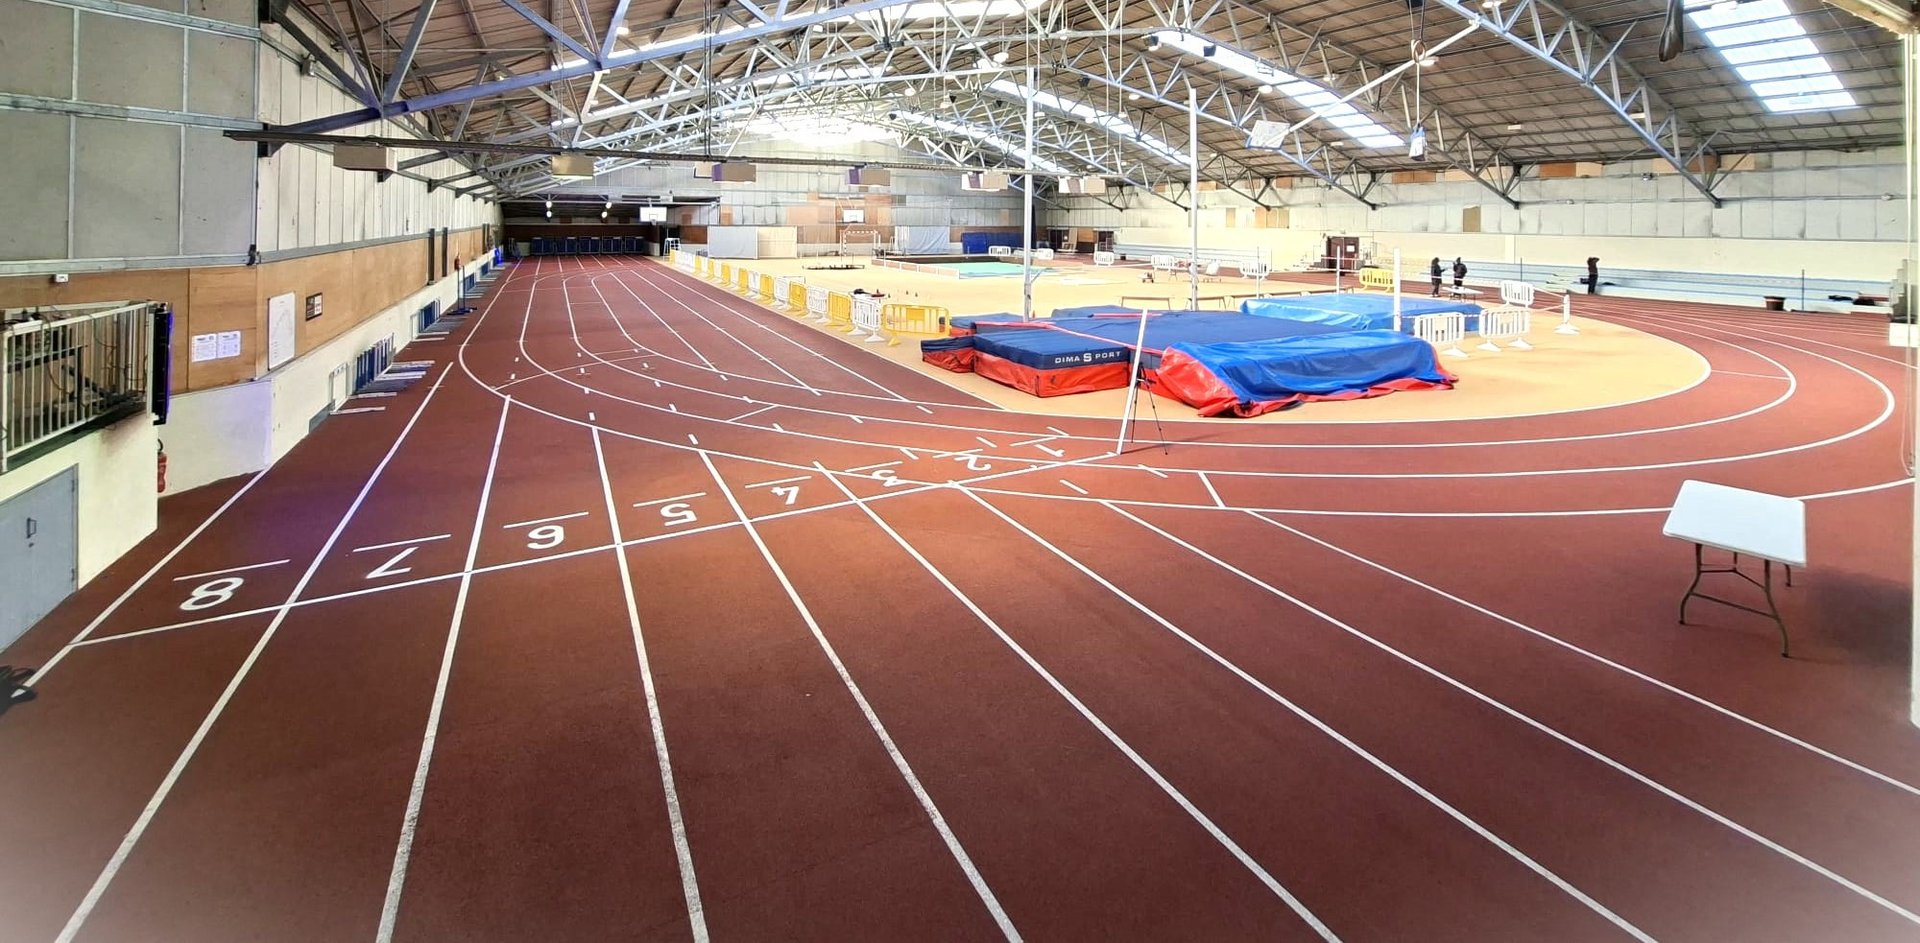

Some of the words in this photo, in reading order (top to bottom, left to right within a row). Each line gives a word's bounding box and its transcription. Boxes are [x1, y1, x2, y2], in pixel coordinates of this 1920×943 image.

[1055, 355, 1080, 364] DIMA
[1034, 444, 1065, 457] 1
[954, 455, 991, 471] 2
[871, 469, 905, 487] 3
[770, 486, 800, 505] 4
[660, 503, 697, 526] 5
[527, 525, 565, 549] 6
[365, 546, 419, 579] 7
[179, 577, 244, 610] 8
